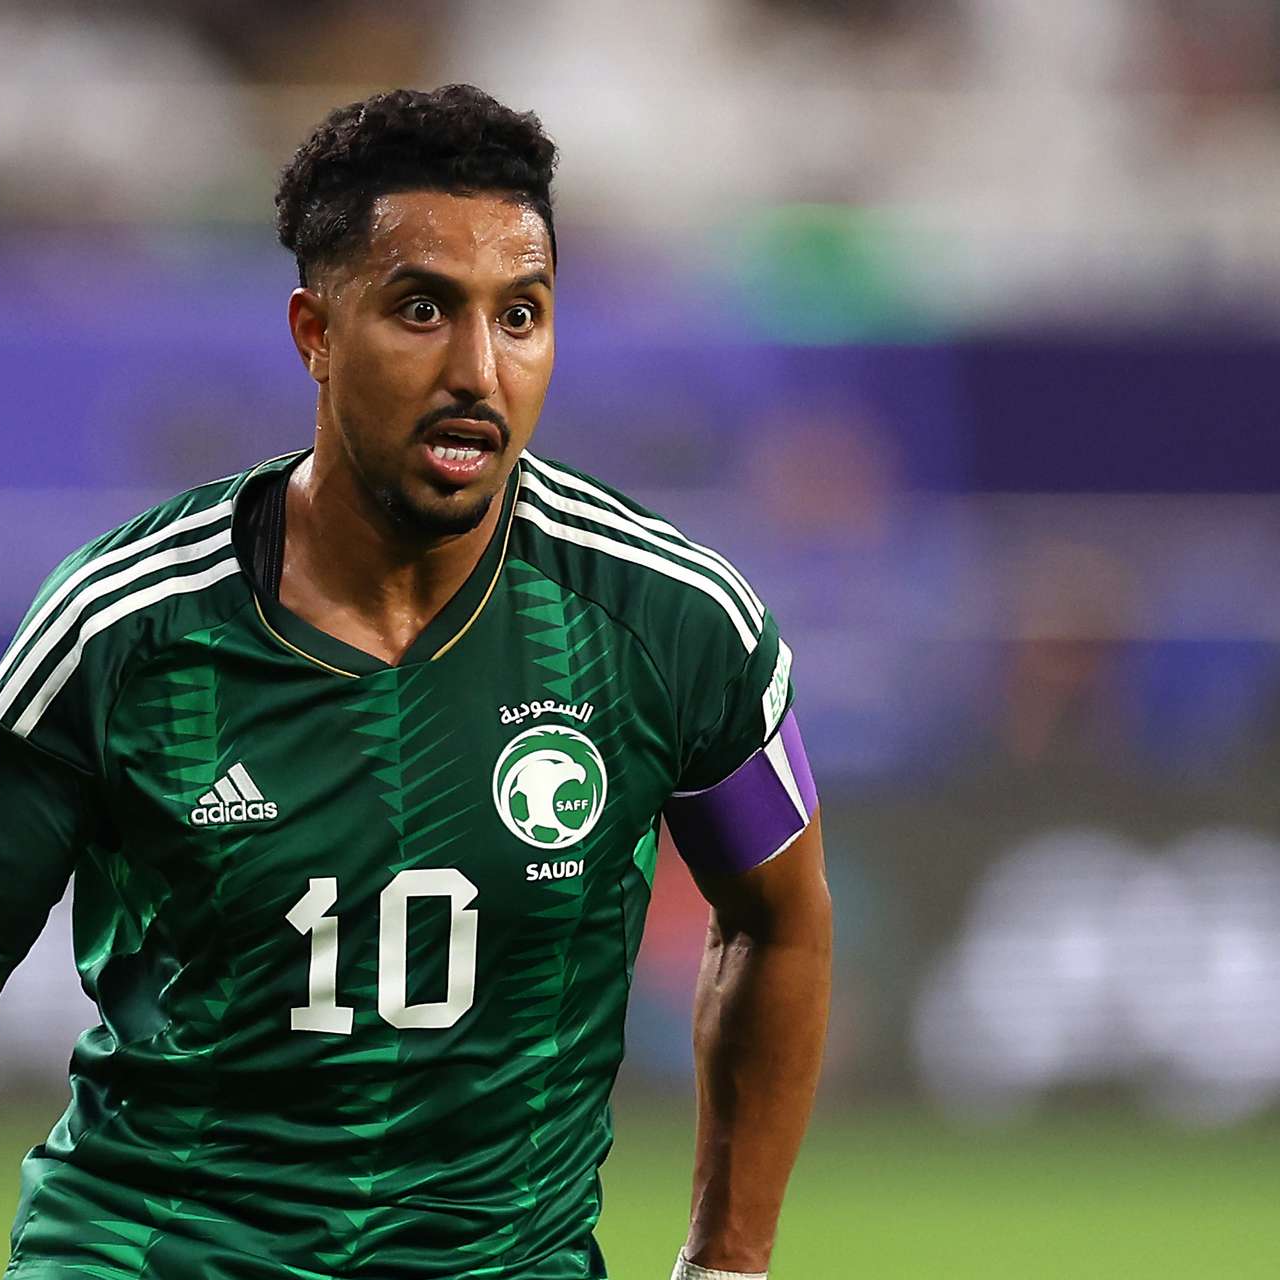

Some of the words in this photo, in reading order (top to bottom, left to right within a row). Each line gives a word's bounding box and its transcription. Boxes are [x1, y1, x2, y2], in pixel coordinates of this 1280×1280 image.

[499, 699, 595, 725] السعودية
[191, 800, 279, 825] adidas
[555, 799, 589, 812] SAFF
[526, 859, 585, 881] SAUDI
[285, 868, 479, 1035] 10
